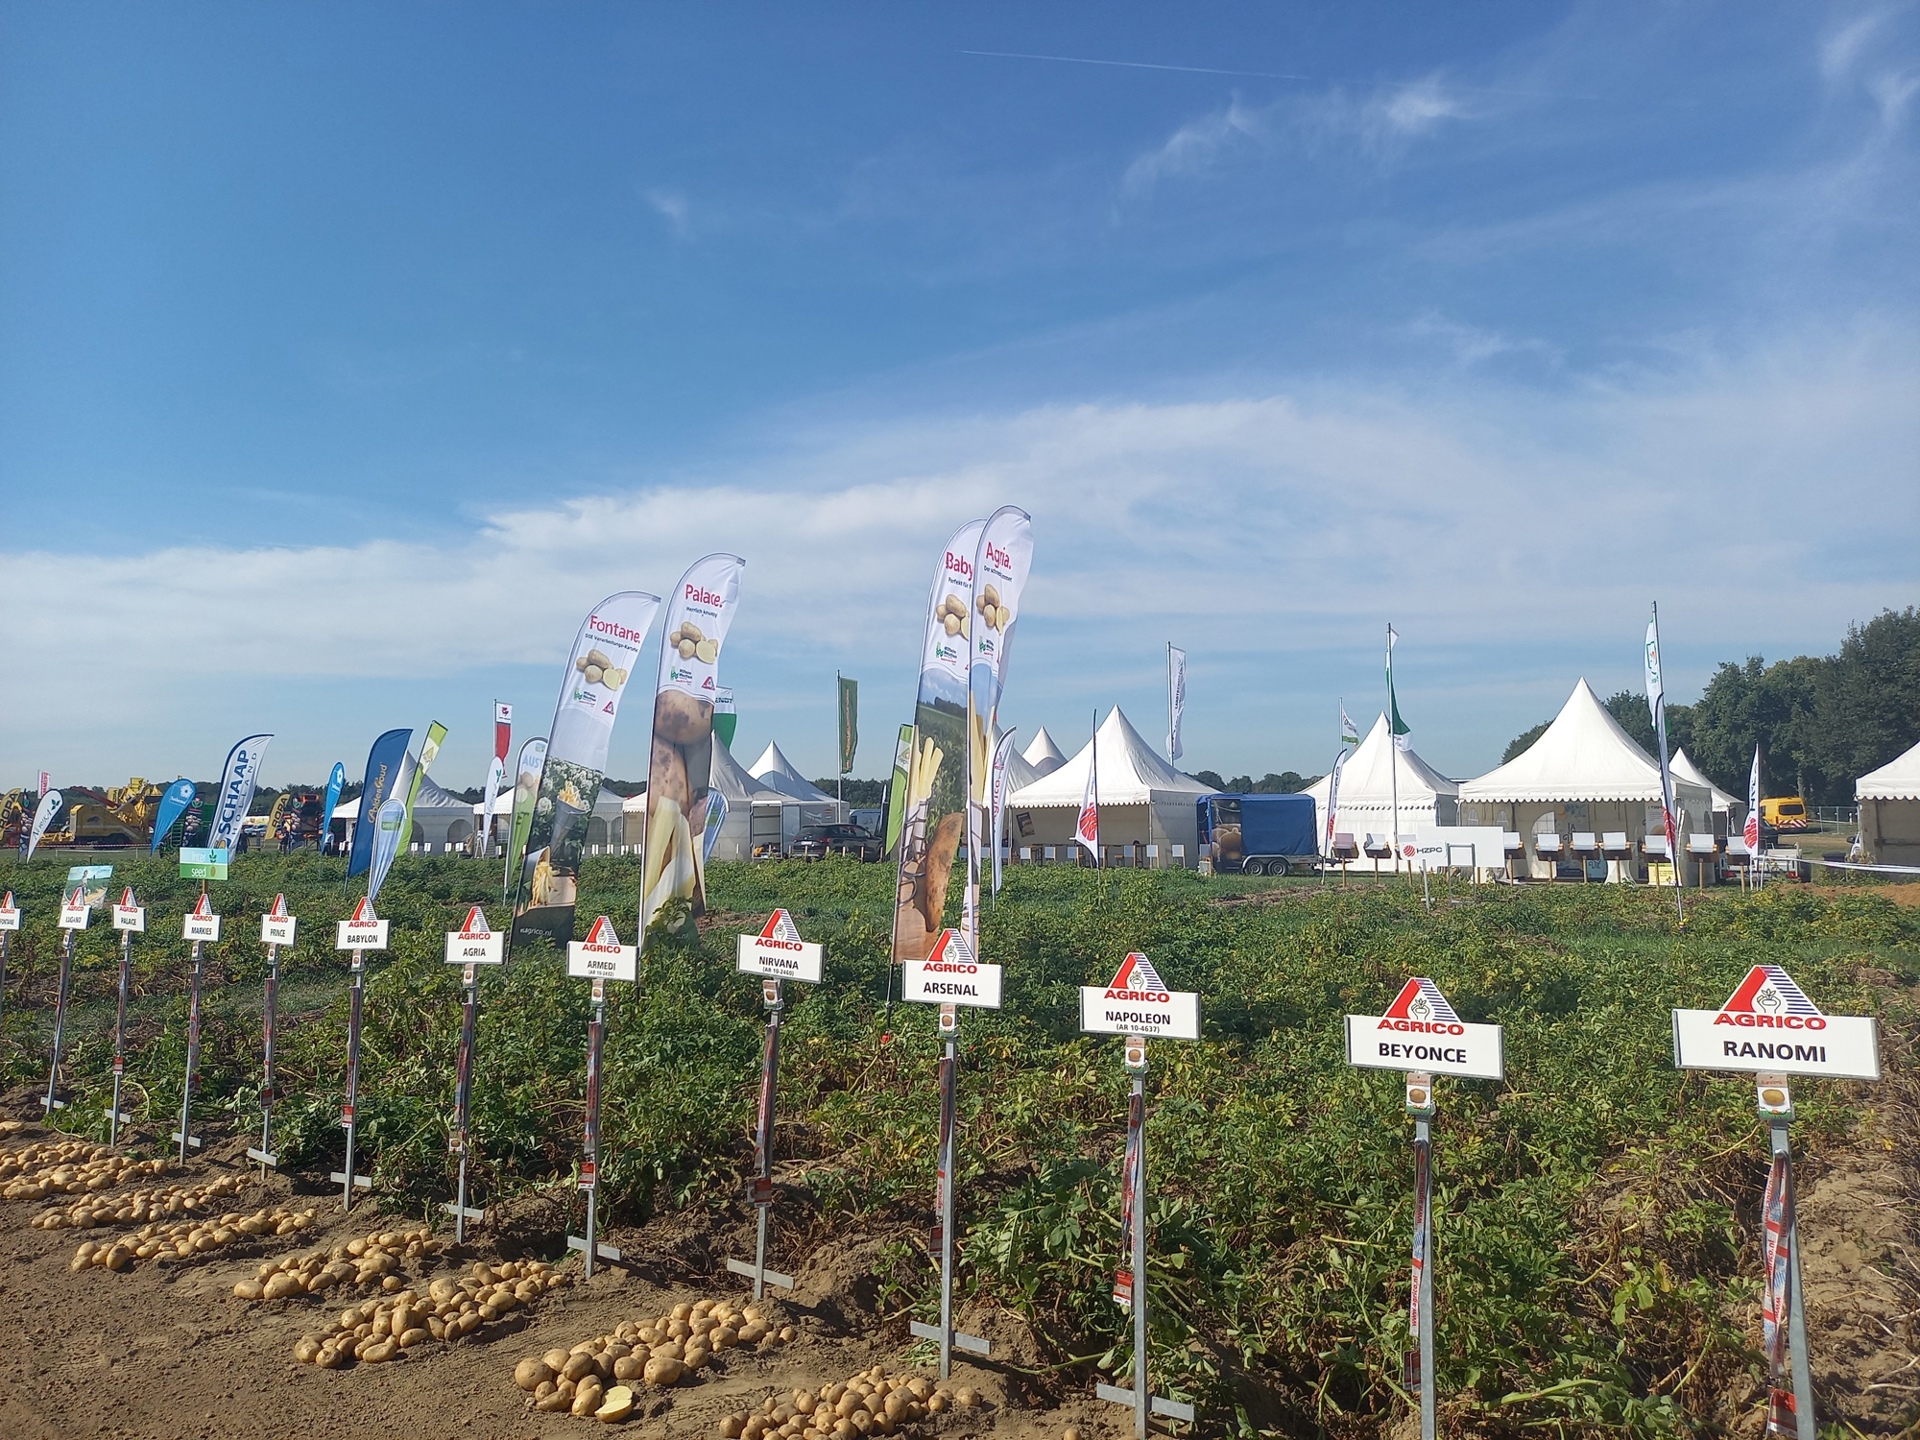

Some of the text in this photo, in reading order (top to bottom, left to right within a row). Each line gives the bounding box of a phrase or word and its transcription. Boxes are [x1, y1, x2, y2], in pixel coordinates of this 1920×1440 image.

[986, 541, 1012, 569] Agria.
[685, 584, 723, 608] Palace.
[589, 615, 641, 644] Fontane.
[219, 749, 257, 835] SCHAAP HOLLAND
[1416, 846, 1443, 854] HZPC
[191, 867, 207, 878] seed
[192, 914, 213, 923] AGRICO
[268, 916, 289, 924] AGRICO
[348, 920, 378, 928] AGRICO
[191, 926, 212, 935] MARKIES
[270, 928, 286, 938] PRINCE
[458, 932, 491, 941] AGRICO
[347, 934, 378, 944] BABYLON
[755, 938, 803, 952] AGRICO
[462, 947, 486, 957] AGRIA
[582, 943, 621, 954] AGRICO
[587, 960, 616, 971] ARMEDI
[758, 956, 799, 970] NIRVANA
[923, 962, 977, 975] AGRICO
[923, 982, 979, 997] ARSENAL
[1104, 989, 1170, 1003] AGRICO
[1105, 1011, 1171, 1025] NAPOLEON
[1713, 1012, 1827, 1031] AGRICO
[1116, 1023, 1160, 1034] (AR 10-4637)
[1376, 1019, 1464, 1036] AGRICO
[1378, 1042, 1467, 1063] BEYONCE
[1723, 1040, 1826, 1062] RANOMI
